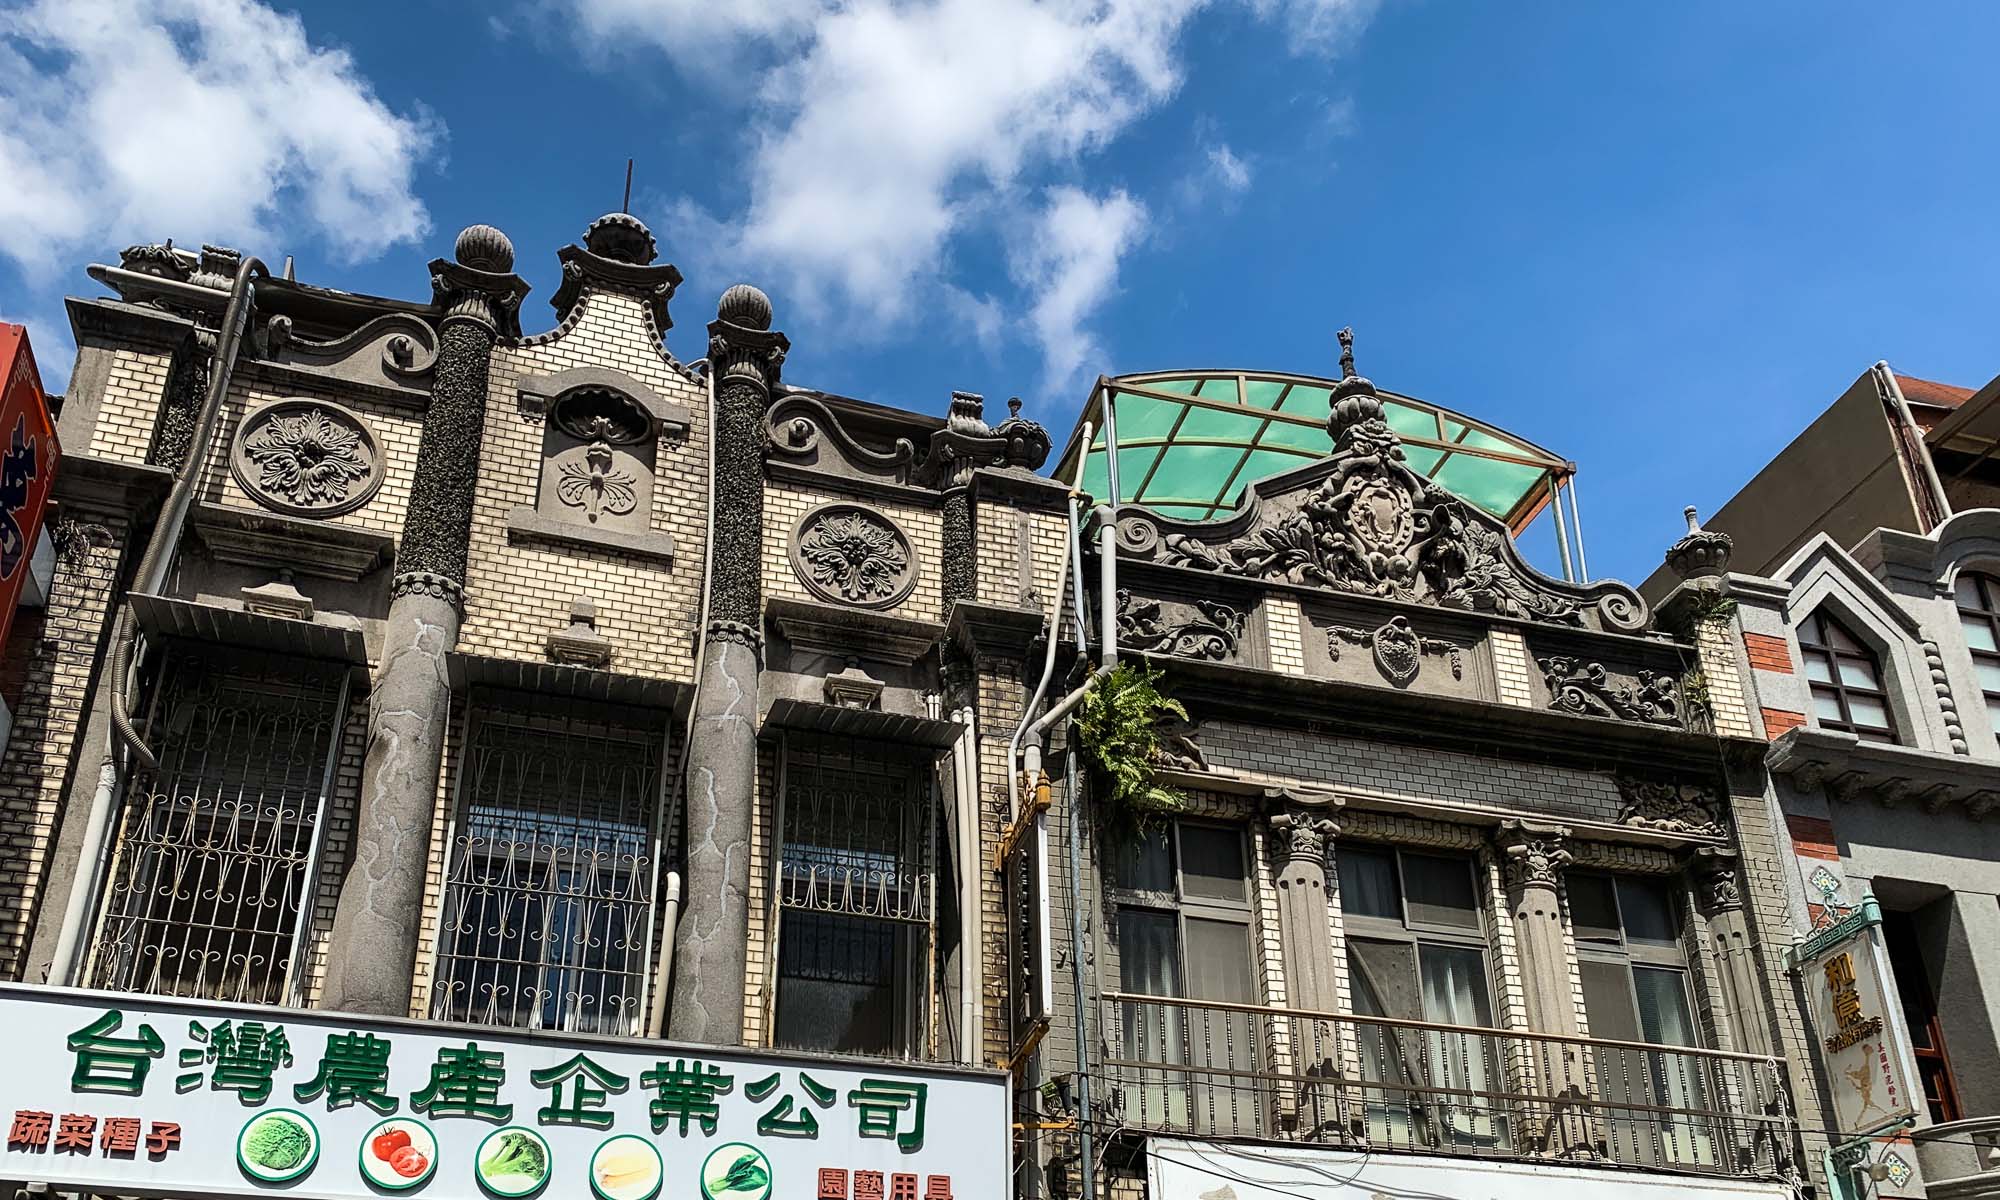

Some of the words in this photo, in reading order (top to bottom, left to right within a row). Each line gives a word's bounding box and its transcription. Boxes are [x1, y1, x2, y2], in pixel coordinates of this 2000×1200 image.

[67, 1008, 928, 1152] 台灣農產企業公司
[7, 1110, 181, 1154] 蔬菜種子
[818, 1167, 954, 1200] 園藝用具
